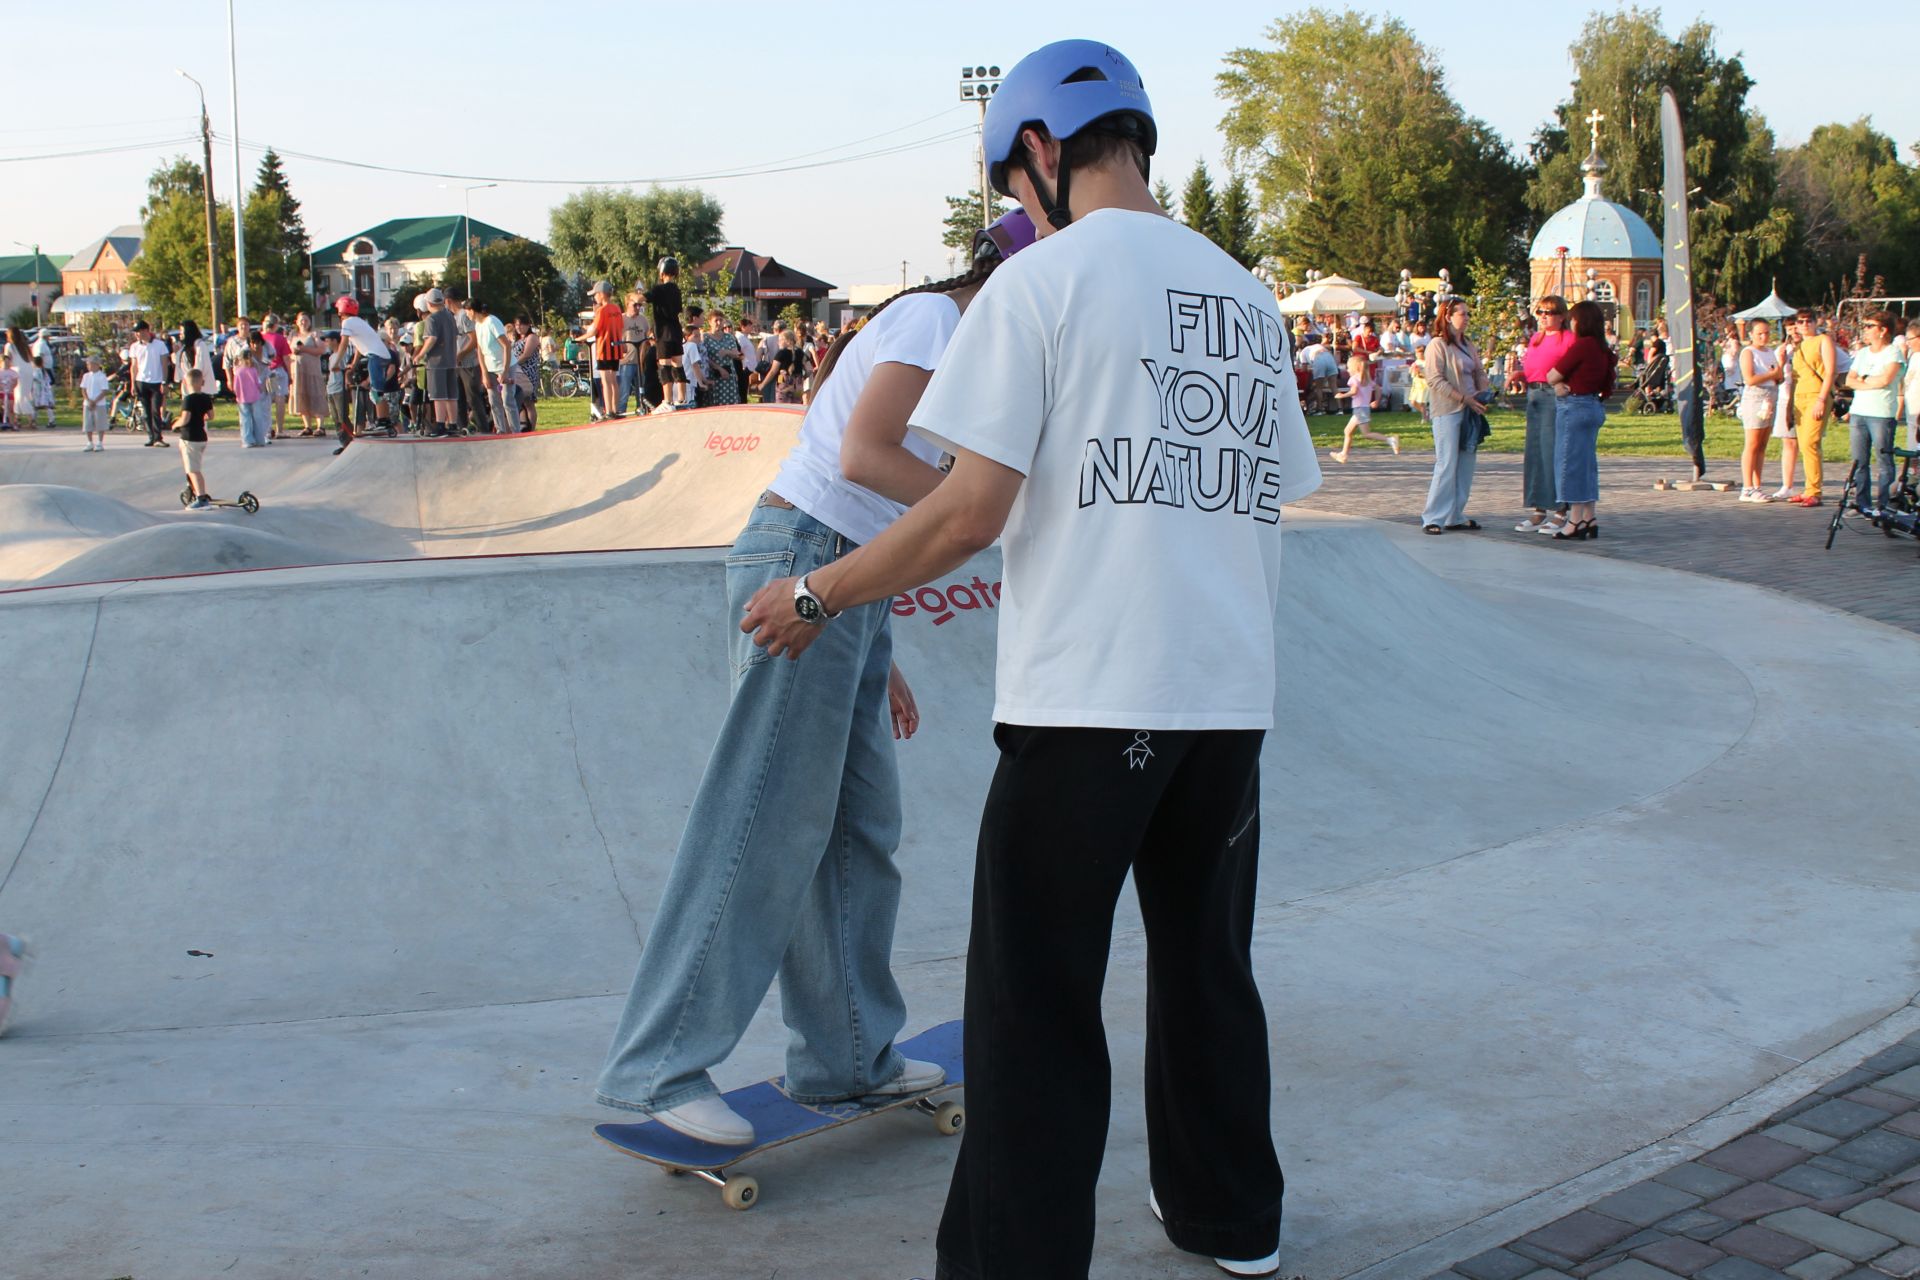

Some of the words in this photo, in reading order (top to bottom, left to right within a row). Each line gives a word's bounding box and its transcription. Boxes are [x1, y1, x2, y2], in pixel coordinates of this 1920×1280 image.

[1166, 288, 1283, 375] FIND
[703, 430, 761, 457] legato
[1078, 436, 1281, 525] NATURE
[890, 575, 1002, 626] egat
